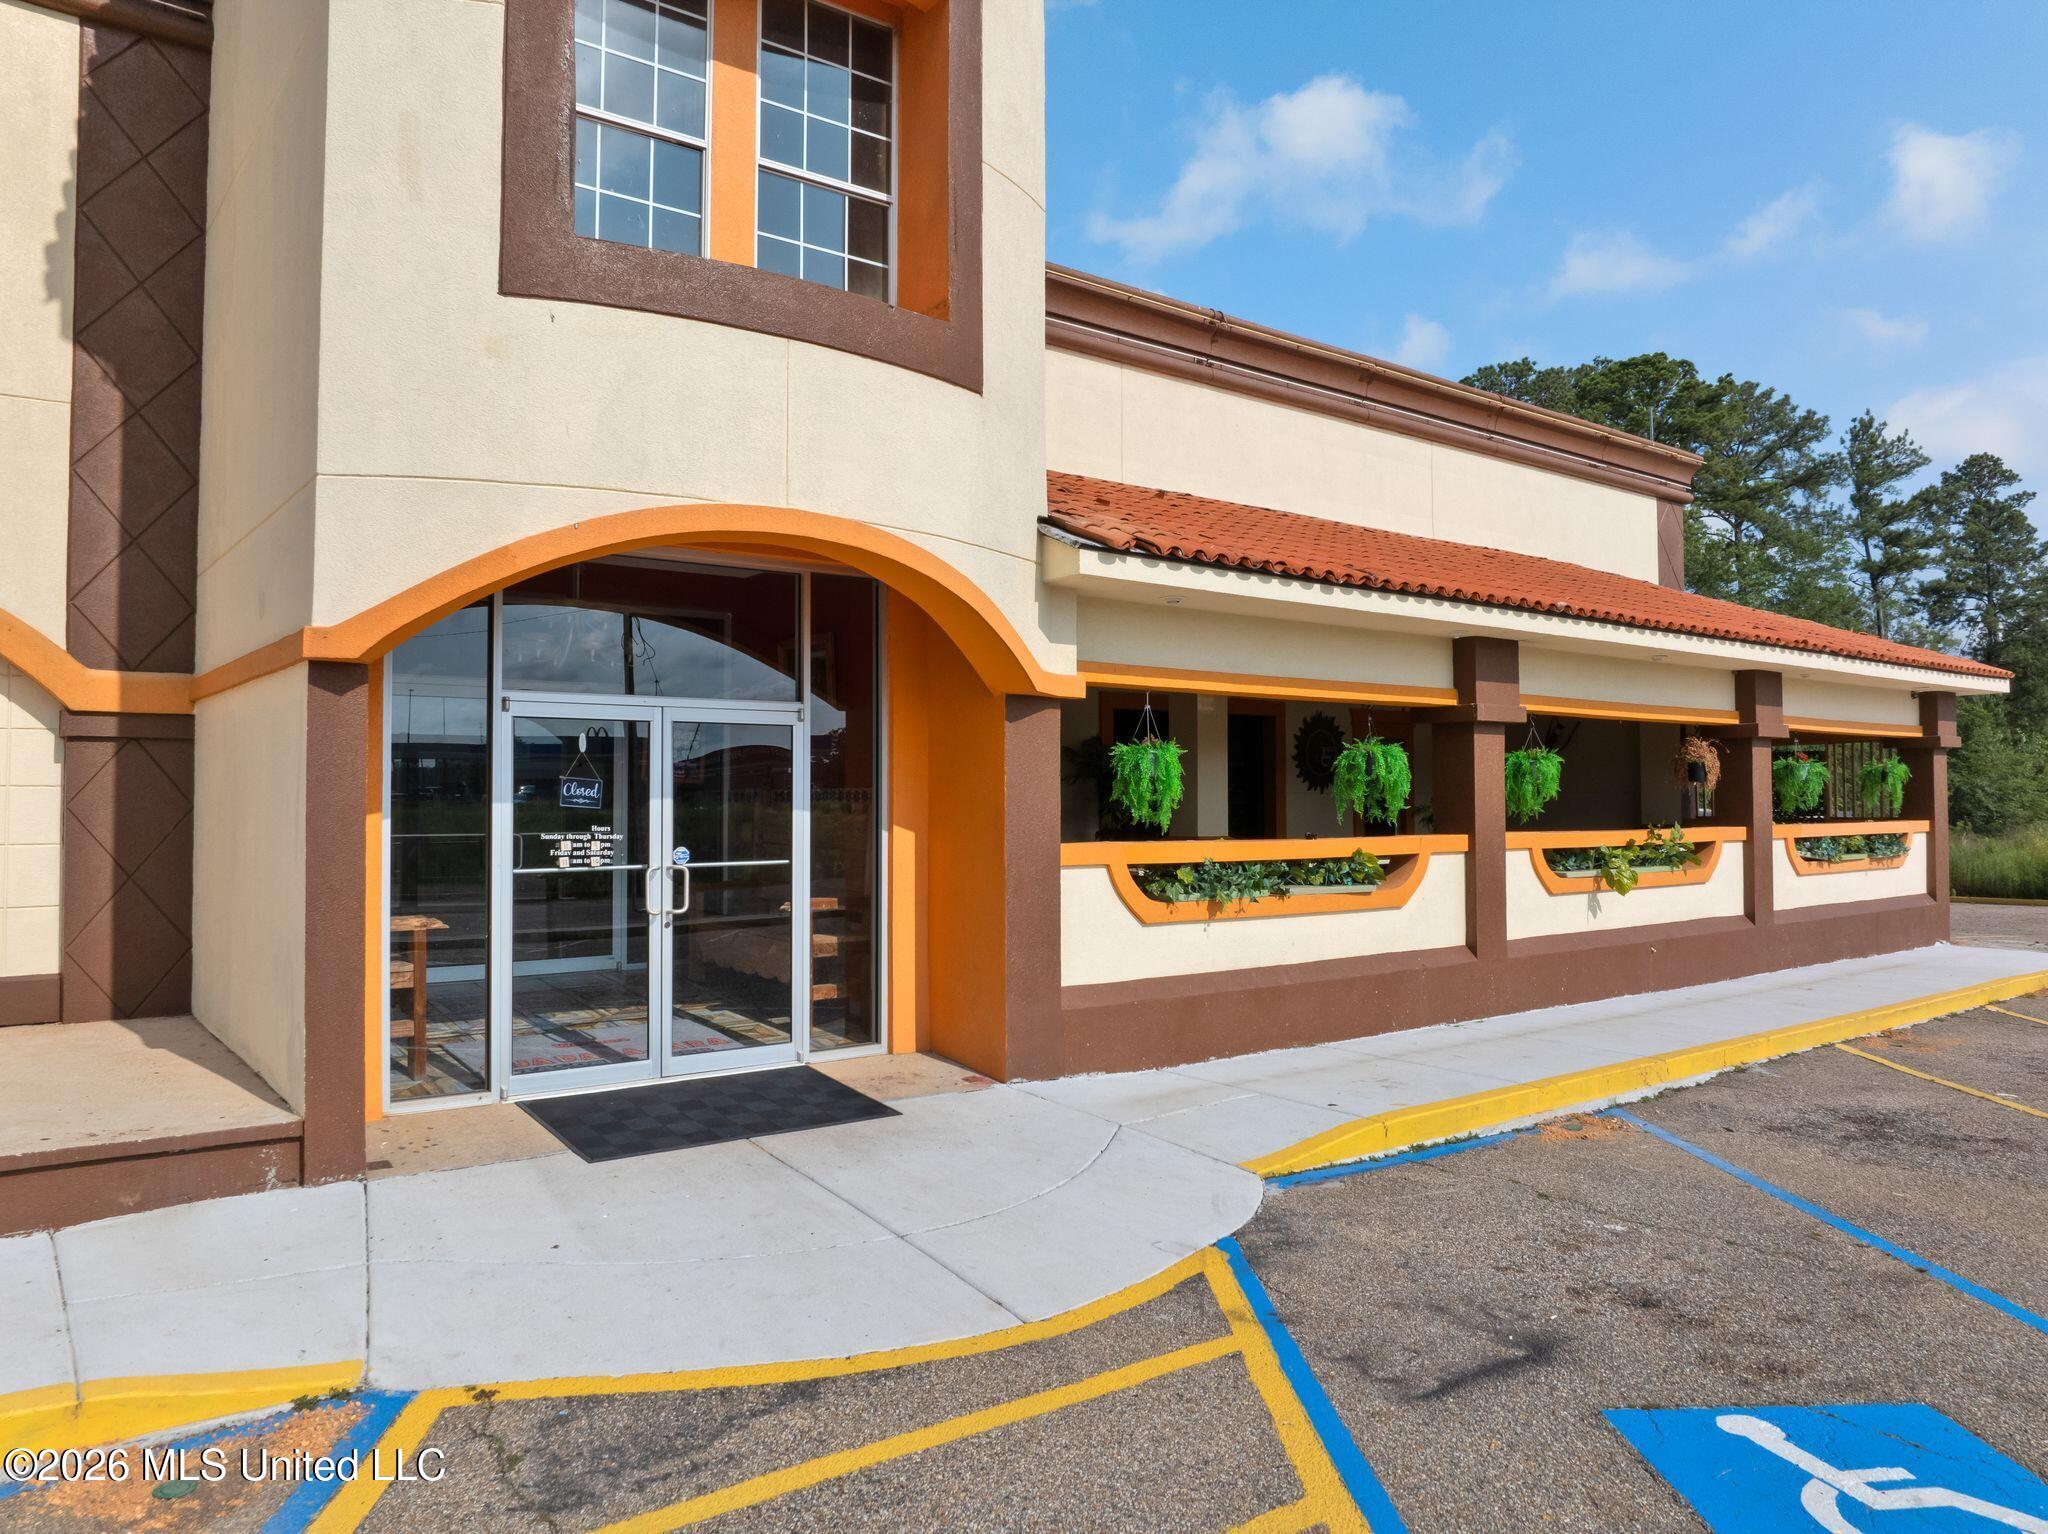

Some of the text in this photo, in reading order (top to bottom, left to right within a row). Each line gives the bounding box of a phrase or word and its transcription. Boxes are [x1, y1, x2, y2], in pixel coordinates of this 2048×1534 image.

[563, 782, 600, 798] Closed
[540, 833, 564, 841] Sunday
[566, 833, 592, 841] through
[586, 849, 615, 857] Saturday
